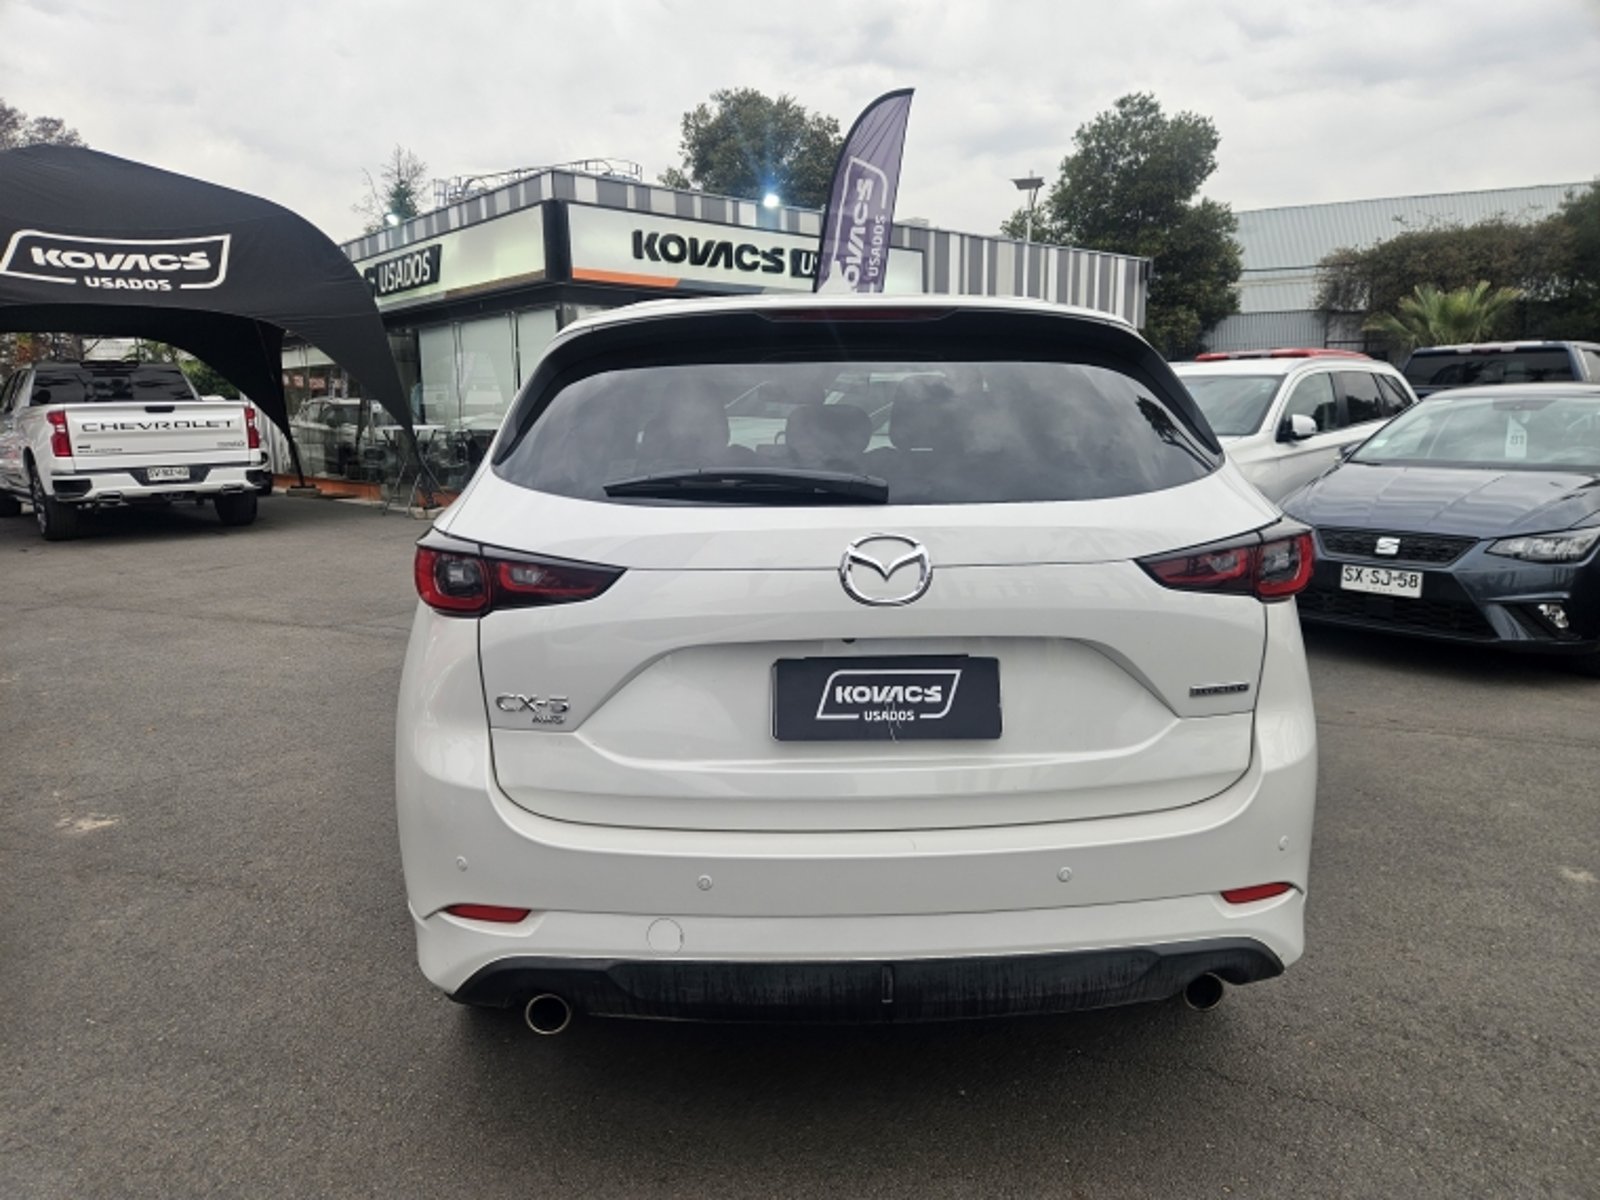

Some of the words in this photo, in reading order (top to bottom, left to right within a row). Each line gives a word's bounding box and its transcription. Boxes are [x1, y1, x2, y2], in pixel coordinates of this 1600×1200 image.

[843, 177, 874, 292] OVACS
[868, 214, 887, 277] USADOS
[31, 246, 211, 272] KOVACS
[631, 229, 785, 275] KOVACS
[84, 276, 172, 291] USADOS
[378, 251, 431, 293] USADOS
[81, 420, 234, 432] CHEVROLET
[495, 693, 570, 714] CX-5
[835, 685, 942, 704] KOVACS
[864, 710, 915, 722] USADOS
